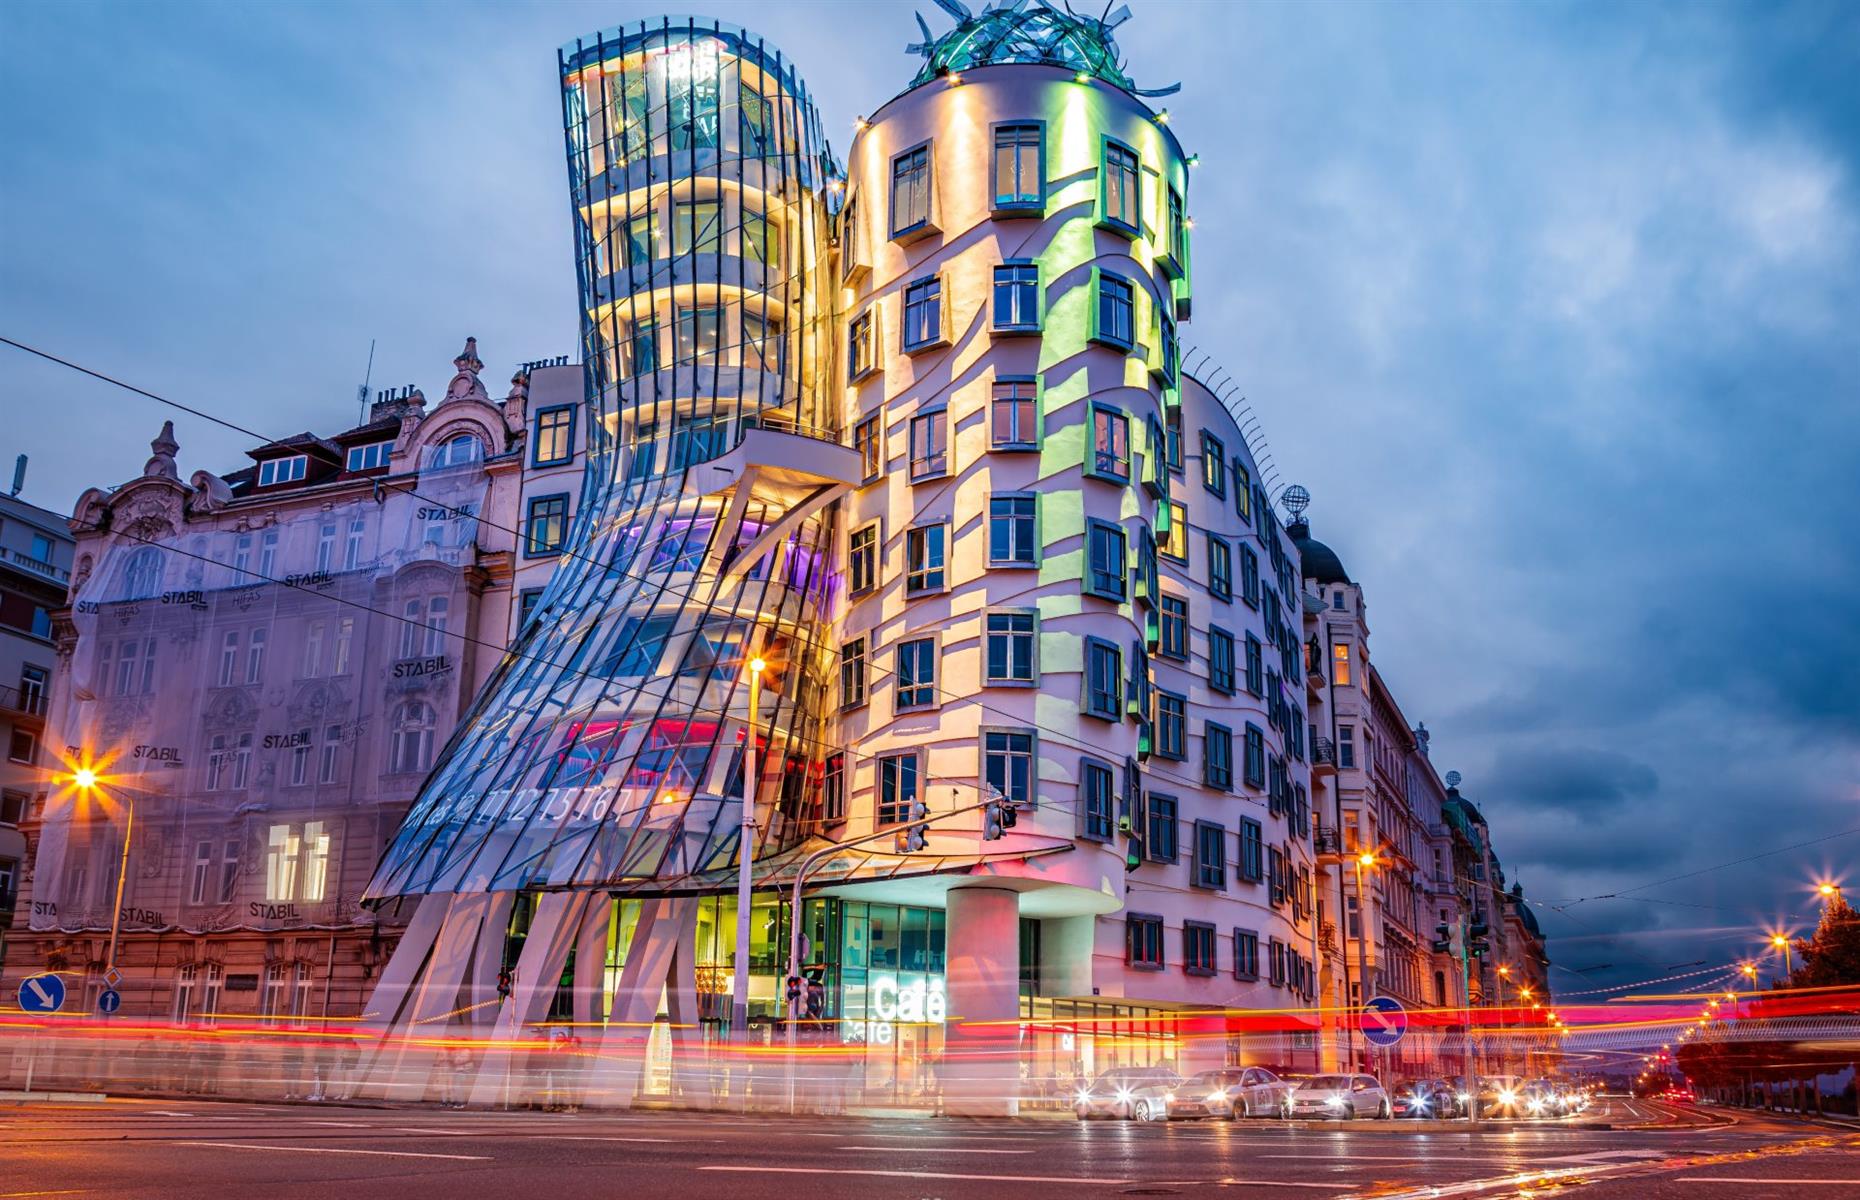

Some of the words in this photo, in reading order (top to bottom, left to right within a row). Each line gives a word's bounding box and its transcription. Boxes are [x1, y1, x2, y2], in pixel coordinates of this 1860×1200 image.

[416, 504, 474, 521] STABIL
[284, 569, 333, 587] STABIL
[161, 590, 208, 605] STABIL
[393, 655, 451, 678] STABIL
[263, 732, 312, 749] STABIL
[133, 745, 182, 762] STABIL
[120, 907, 169, 927] STABIL
[249, 901, 300, 920] STABIL
